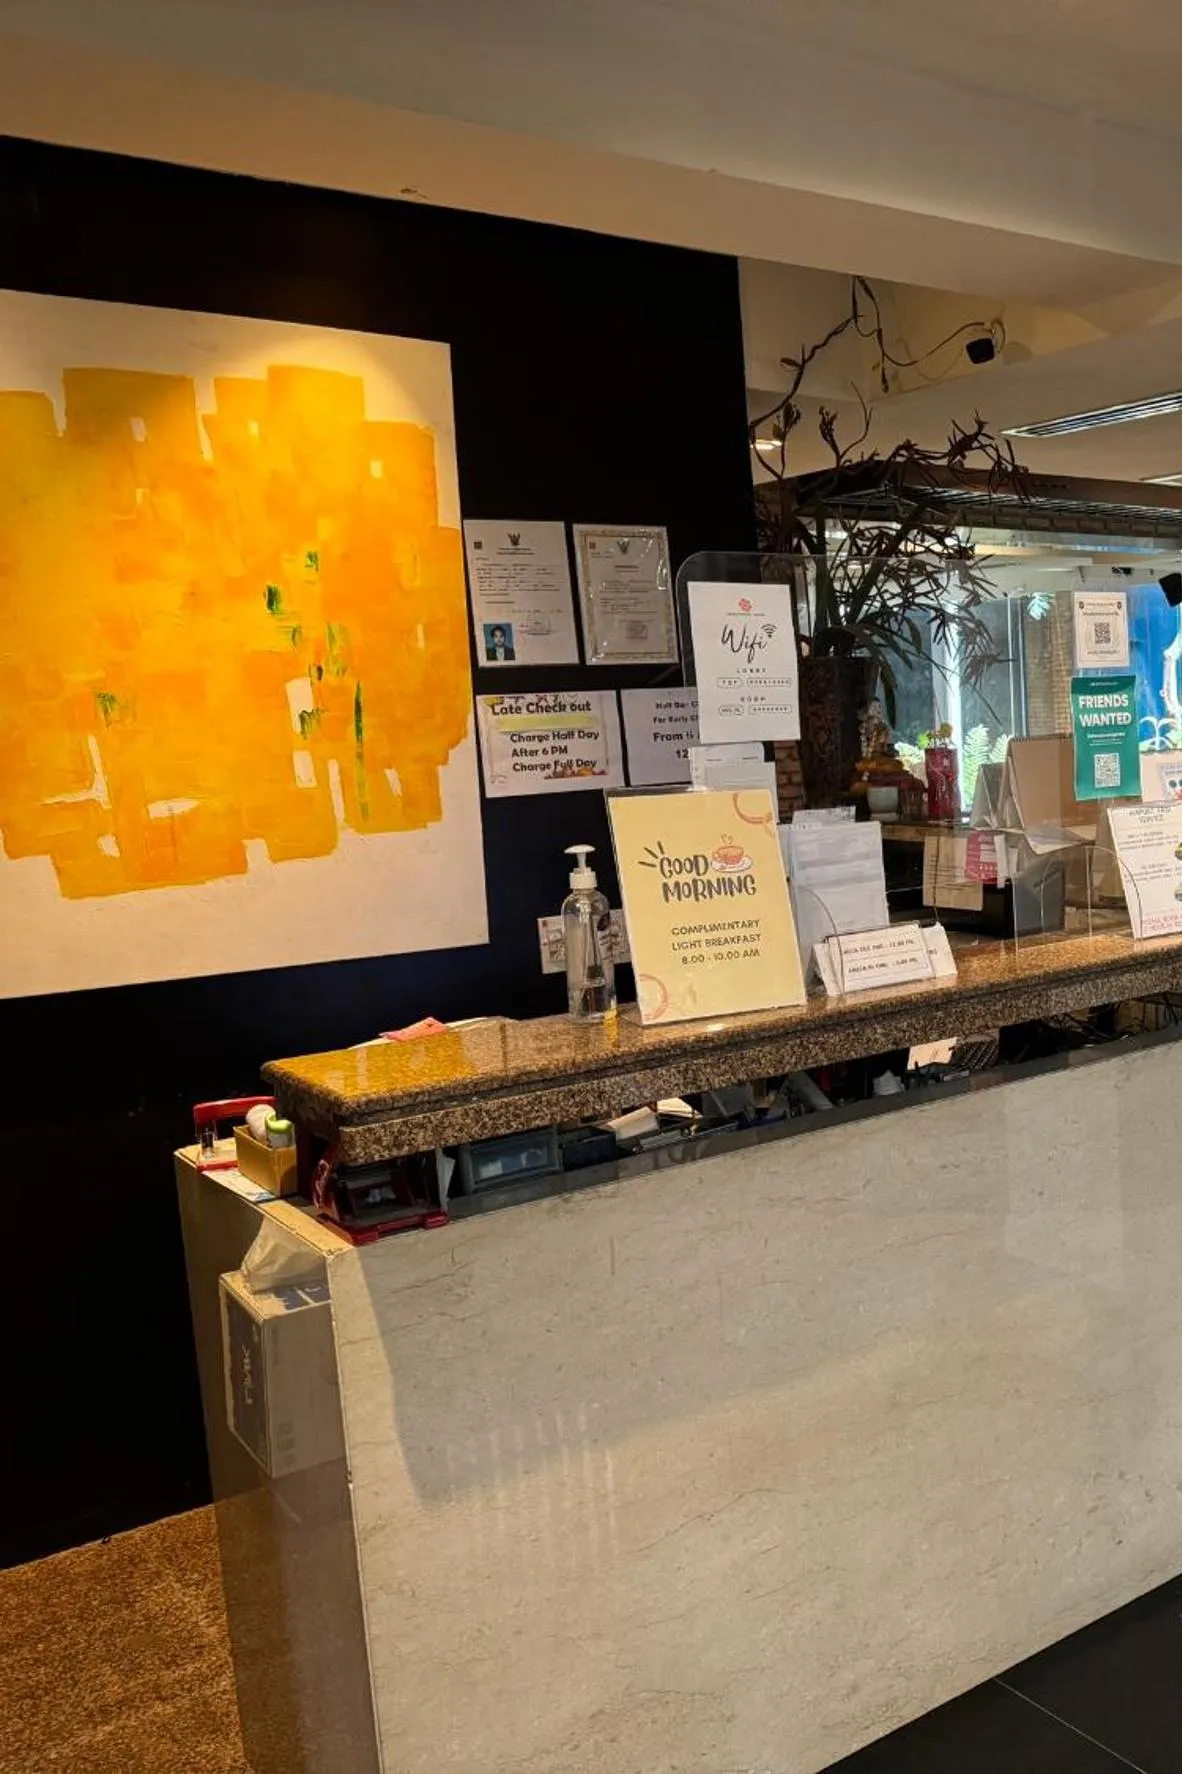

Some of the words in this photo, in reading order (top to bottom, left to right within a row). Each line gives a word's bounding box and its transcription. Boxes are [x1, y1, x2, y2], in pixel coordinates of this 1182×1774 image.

[721, 624, 768, 664] Wifi
[491, 703, 522, 715] Late
[526, 702, 566, 714] Check
[570, 700, 592, 712] out
[1079, 694, 1129, 709] FRIENDS
[1079, 712, 1132, 728] WANTED
[510, 733, 550, 744] Charge
[552, 730, 576, 740] Half
[577, 730, 599, 741] Day
[653, 732, 683, 742] From
[512, 748, 539, 758] After
[541, 746, 549, 756] 6
[551, 745, 568, 755] PM
[512, 762, 551, 773] Charge
[554, 759, 574, 770] Full
[576, 758, 597, 769] Day
[660, 854, 709, 879] GOOD
[661, 874, 757, 904] MORNING
[672, 940, 702, 951] LIGHT
[705, 934, 761, 948] BREAKFAST
[713, 951, 740, 962] 10.00
[743, 948, 760, 957] AM
